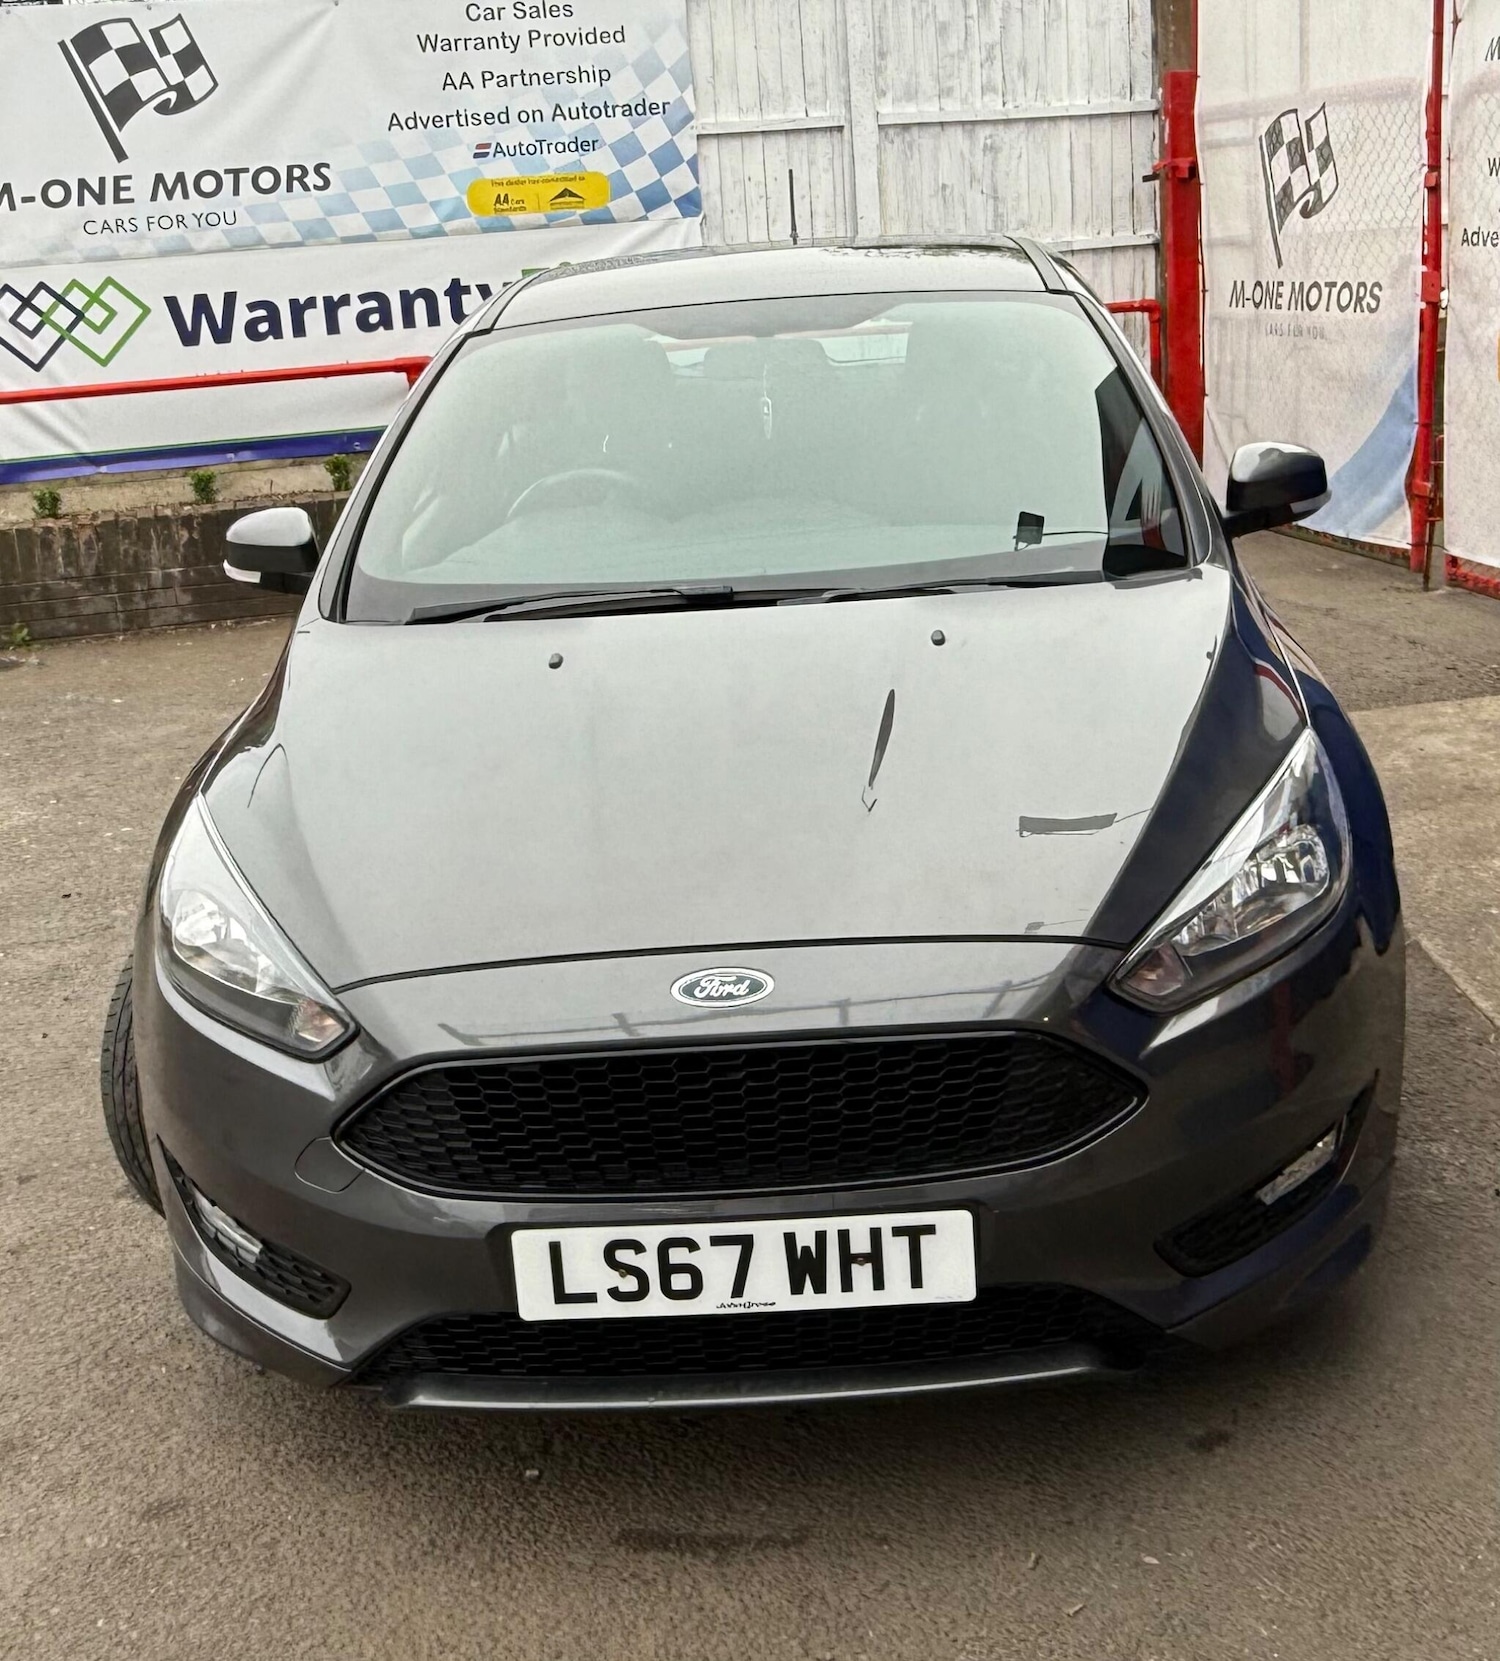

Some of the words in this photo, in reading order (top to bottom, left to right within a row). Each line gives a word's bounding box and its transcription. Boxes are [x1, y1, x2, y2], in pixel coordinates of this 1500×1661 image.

[465, 2, 506, 22] Car
[513, 1, 574, 20] Sales
[417, 31, 521, 54] Warranty
[528, 25, 626, 48] Provided
[442, 71, 474, 91] AA
[482, 65, 612, 89] Partnership
[387, 105, 510, 132] Advertised
[517, 107, 544, 124] on
[551, 98, 671, 123] Autotrader
[492, 136, 600, 159] AutoTrader
[149, 162, 332, 202] MOTORS
[83, 217, 139, 236] CARS
[146, 213, 187, 232] FOR
[191, 210, 238, 229] YOU
[1228, 280, 1285, 310] M-ONE
[1287, 280, 1383, 314] MOTORS
[693, 975, 751, 999] Ford
[548, 1233, 755, 1305] LS67
[782, 1224, 937, 1296] WHT
